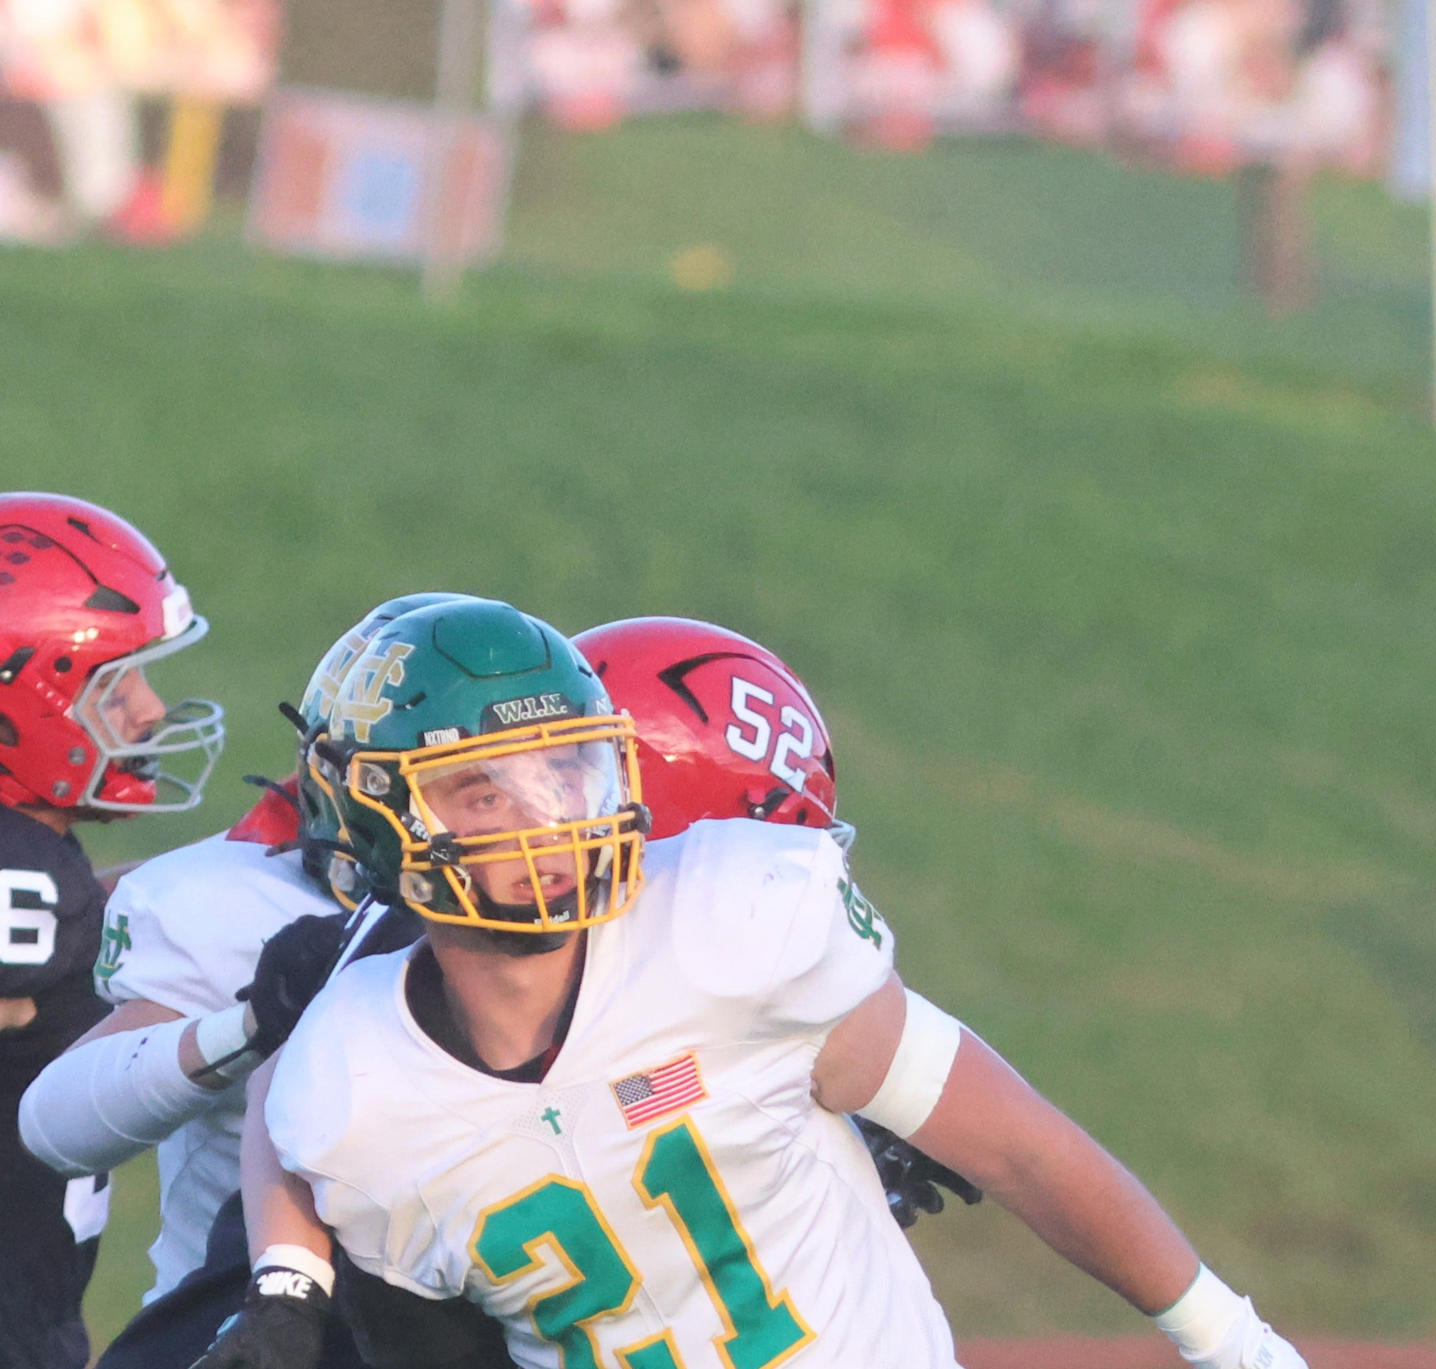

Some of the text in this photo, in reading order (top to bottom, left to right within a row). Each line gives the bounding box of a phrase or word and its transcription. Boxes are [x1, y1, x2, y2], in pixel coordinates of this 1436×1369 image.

[494, 693, 568, 724] W.I.N.
[724, 674, 813, 793] 52
[0, 868, 58, 965] 6
